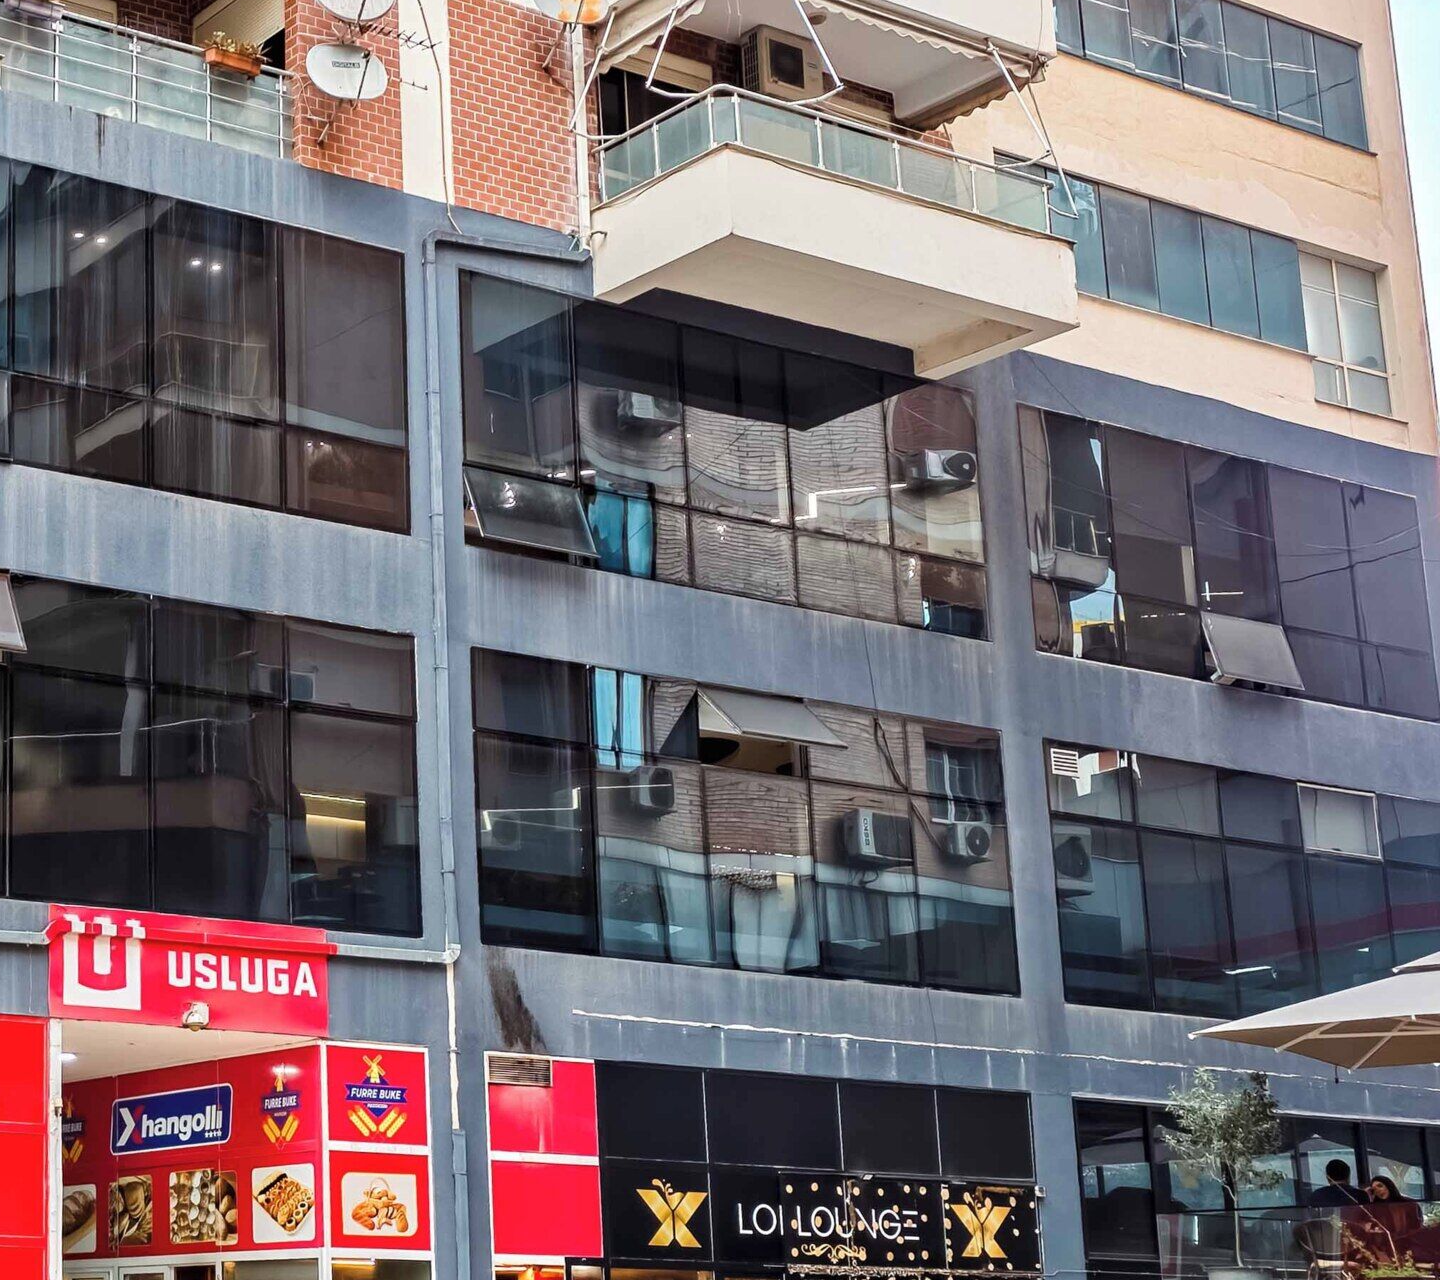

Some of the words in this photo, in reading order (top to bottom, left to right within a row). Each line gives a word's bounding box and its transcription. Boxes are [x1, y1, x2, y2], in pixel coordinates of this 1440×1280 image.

[167, 950, 318, 998] USLUGA
[350, 1087, 378, 1099] FURRE
[379, 1089, 402, 1100] BUKE
[796, 1205, 921, 1242] LOUNGE
